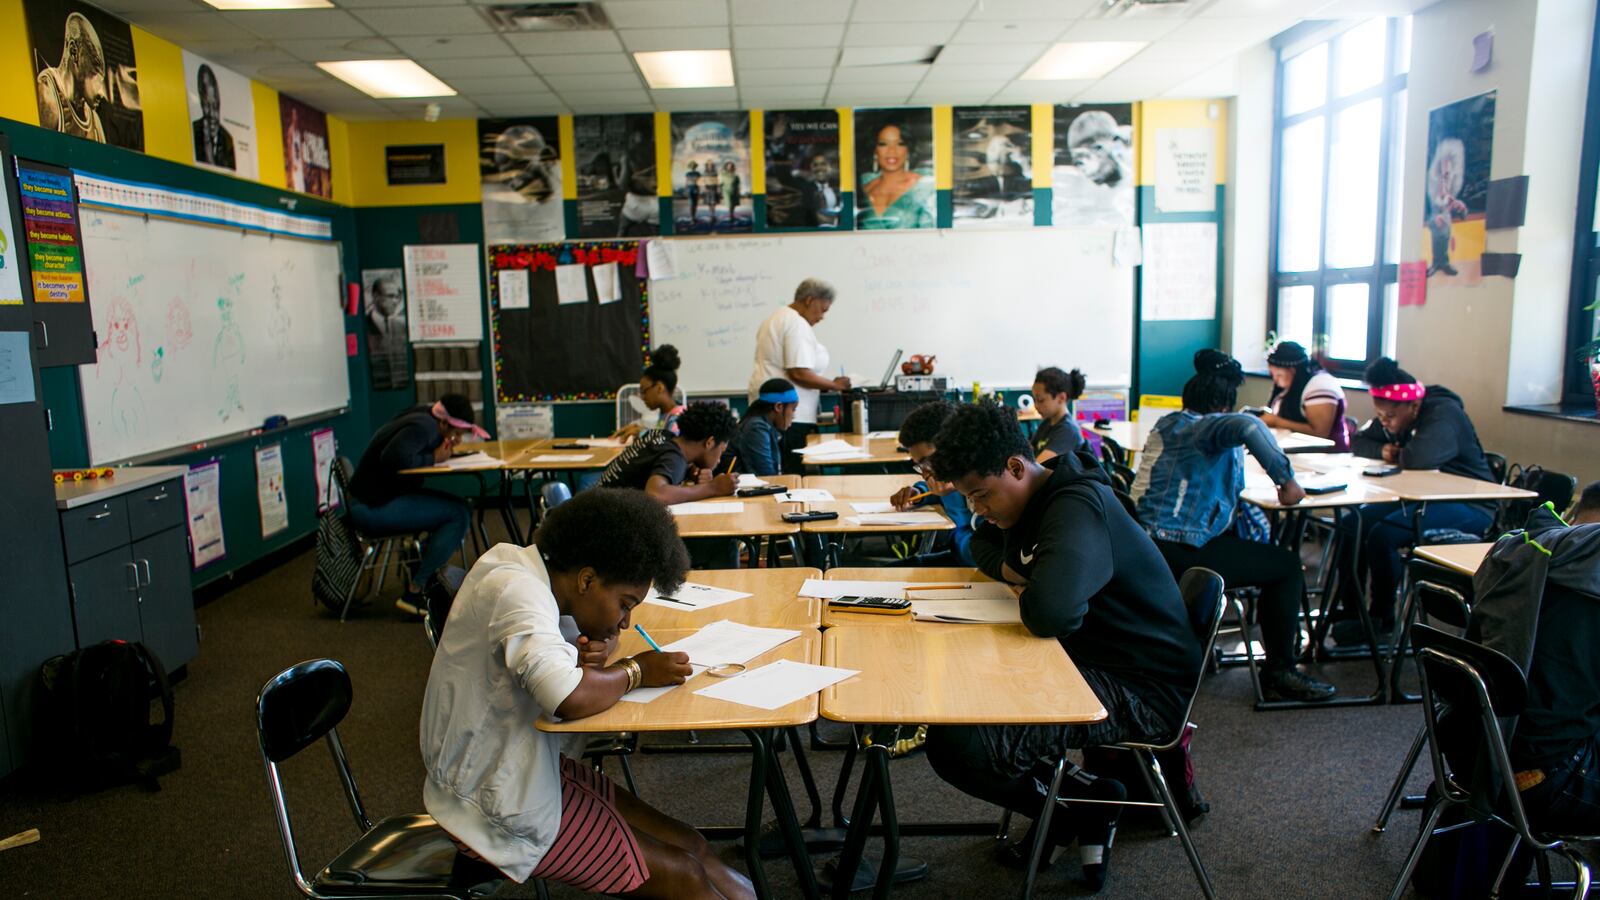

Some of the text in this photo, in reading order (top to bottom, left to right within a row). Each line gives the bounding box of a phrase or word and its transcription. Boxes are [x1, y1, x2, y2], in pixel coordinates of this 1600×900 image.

[34, 184, 53, 194] become
[36, 208, 55, 217] become
[40, 231, 58, 240] become
[42, 281, 65, 289] becomes
